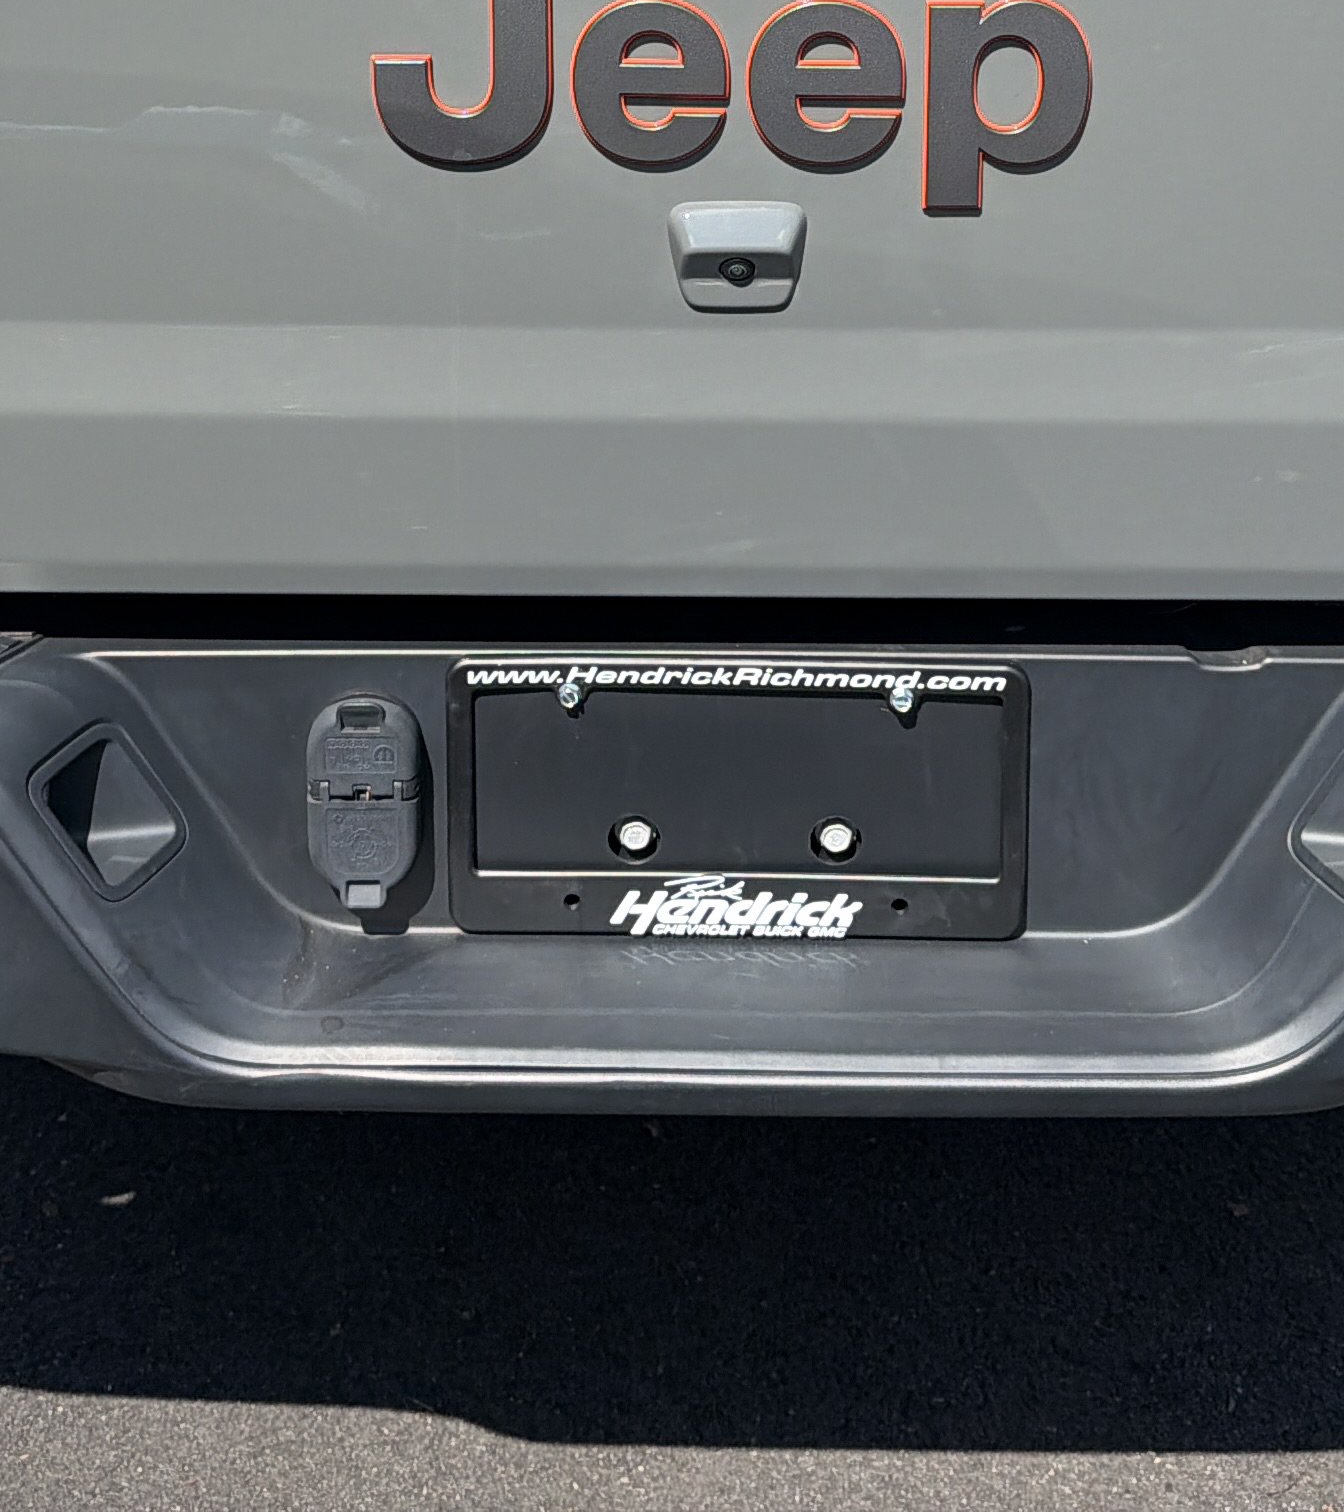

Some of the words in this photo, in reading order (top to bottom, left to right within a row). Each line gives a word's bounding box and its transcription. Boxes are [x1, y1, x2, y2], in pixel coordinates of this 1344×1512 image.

[466, 665, 1007, 692] www.HendrickRichmond.com
[609, 890, 864, 935] Hendrick
[651, 923, 751, 937] CHEVROLET
[752, 924, 805, 937] BUICK
[807, 925, 848, 938] GMC
